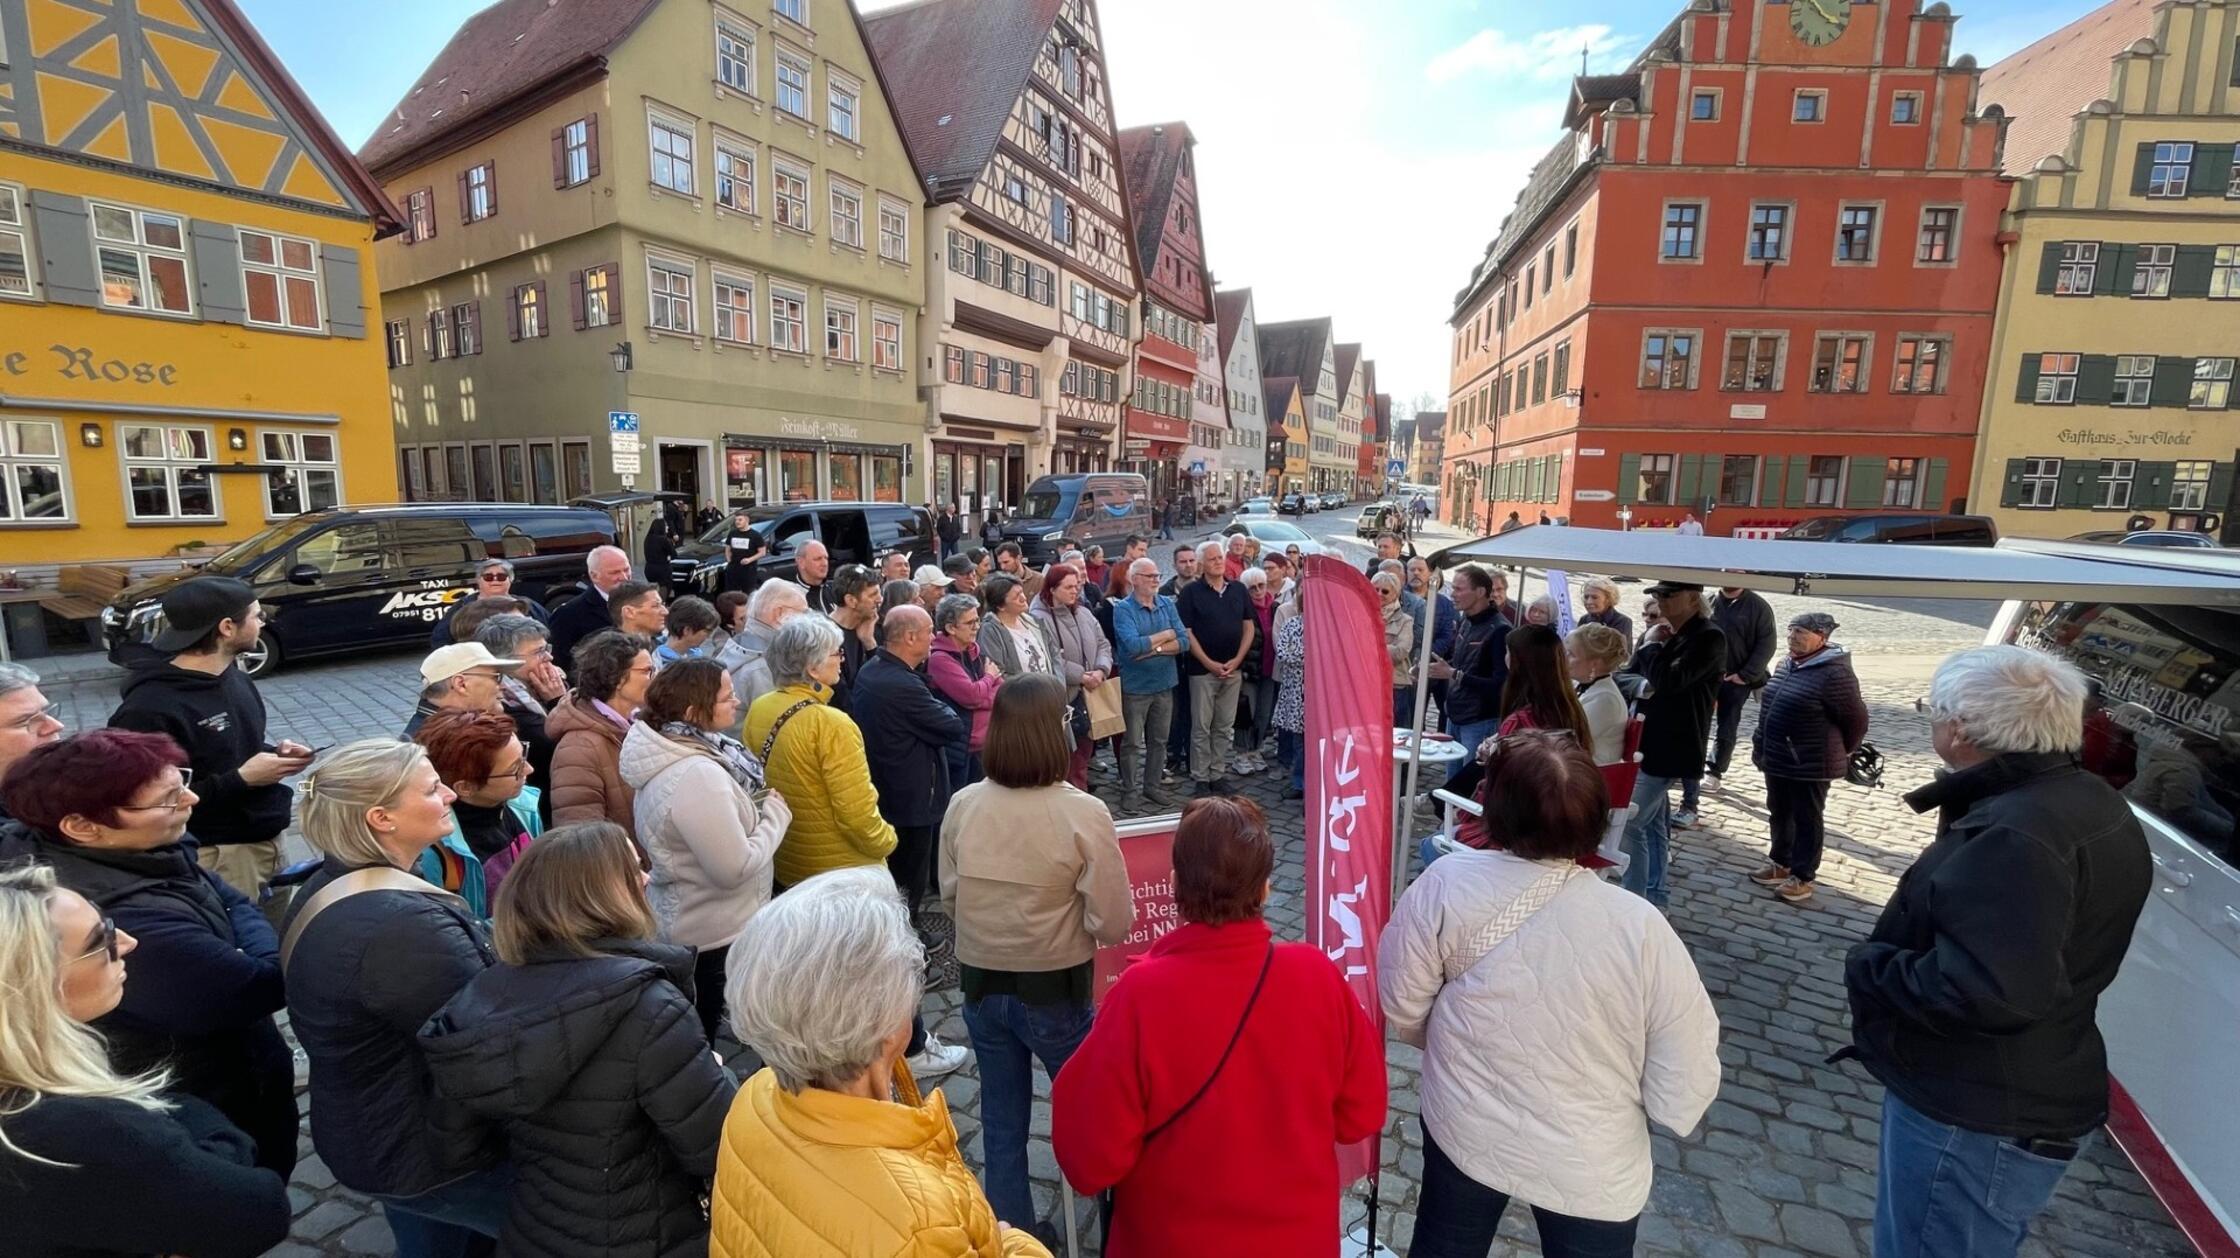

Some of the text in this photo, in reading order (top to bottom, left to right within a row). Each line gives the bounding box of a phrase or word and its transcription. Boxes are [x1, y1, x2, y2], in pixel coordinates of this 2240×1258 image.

[49, 344, 178, 386] Rose
[420, 579, 449, 589] TAXI
[379, 587, 479, 614] AKSO
[1145, 901, 1179, 919] Reg
